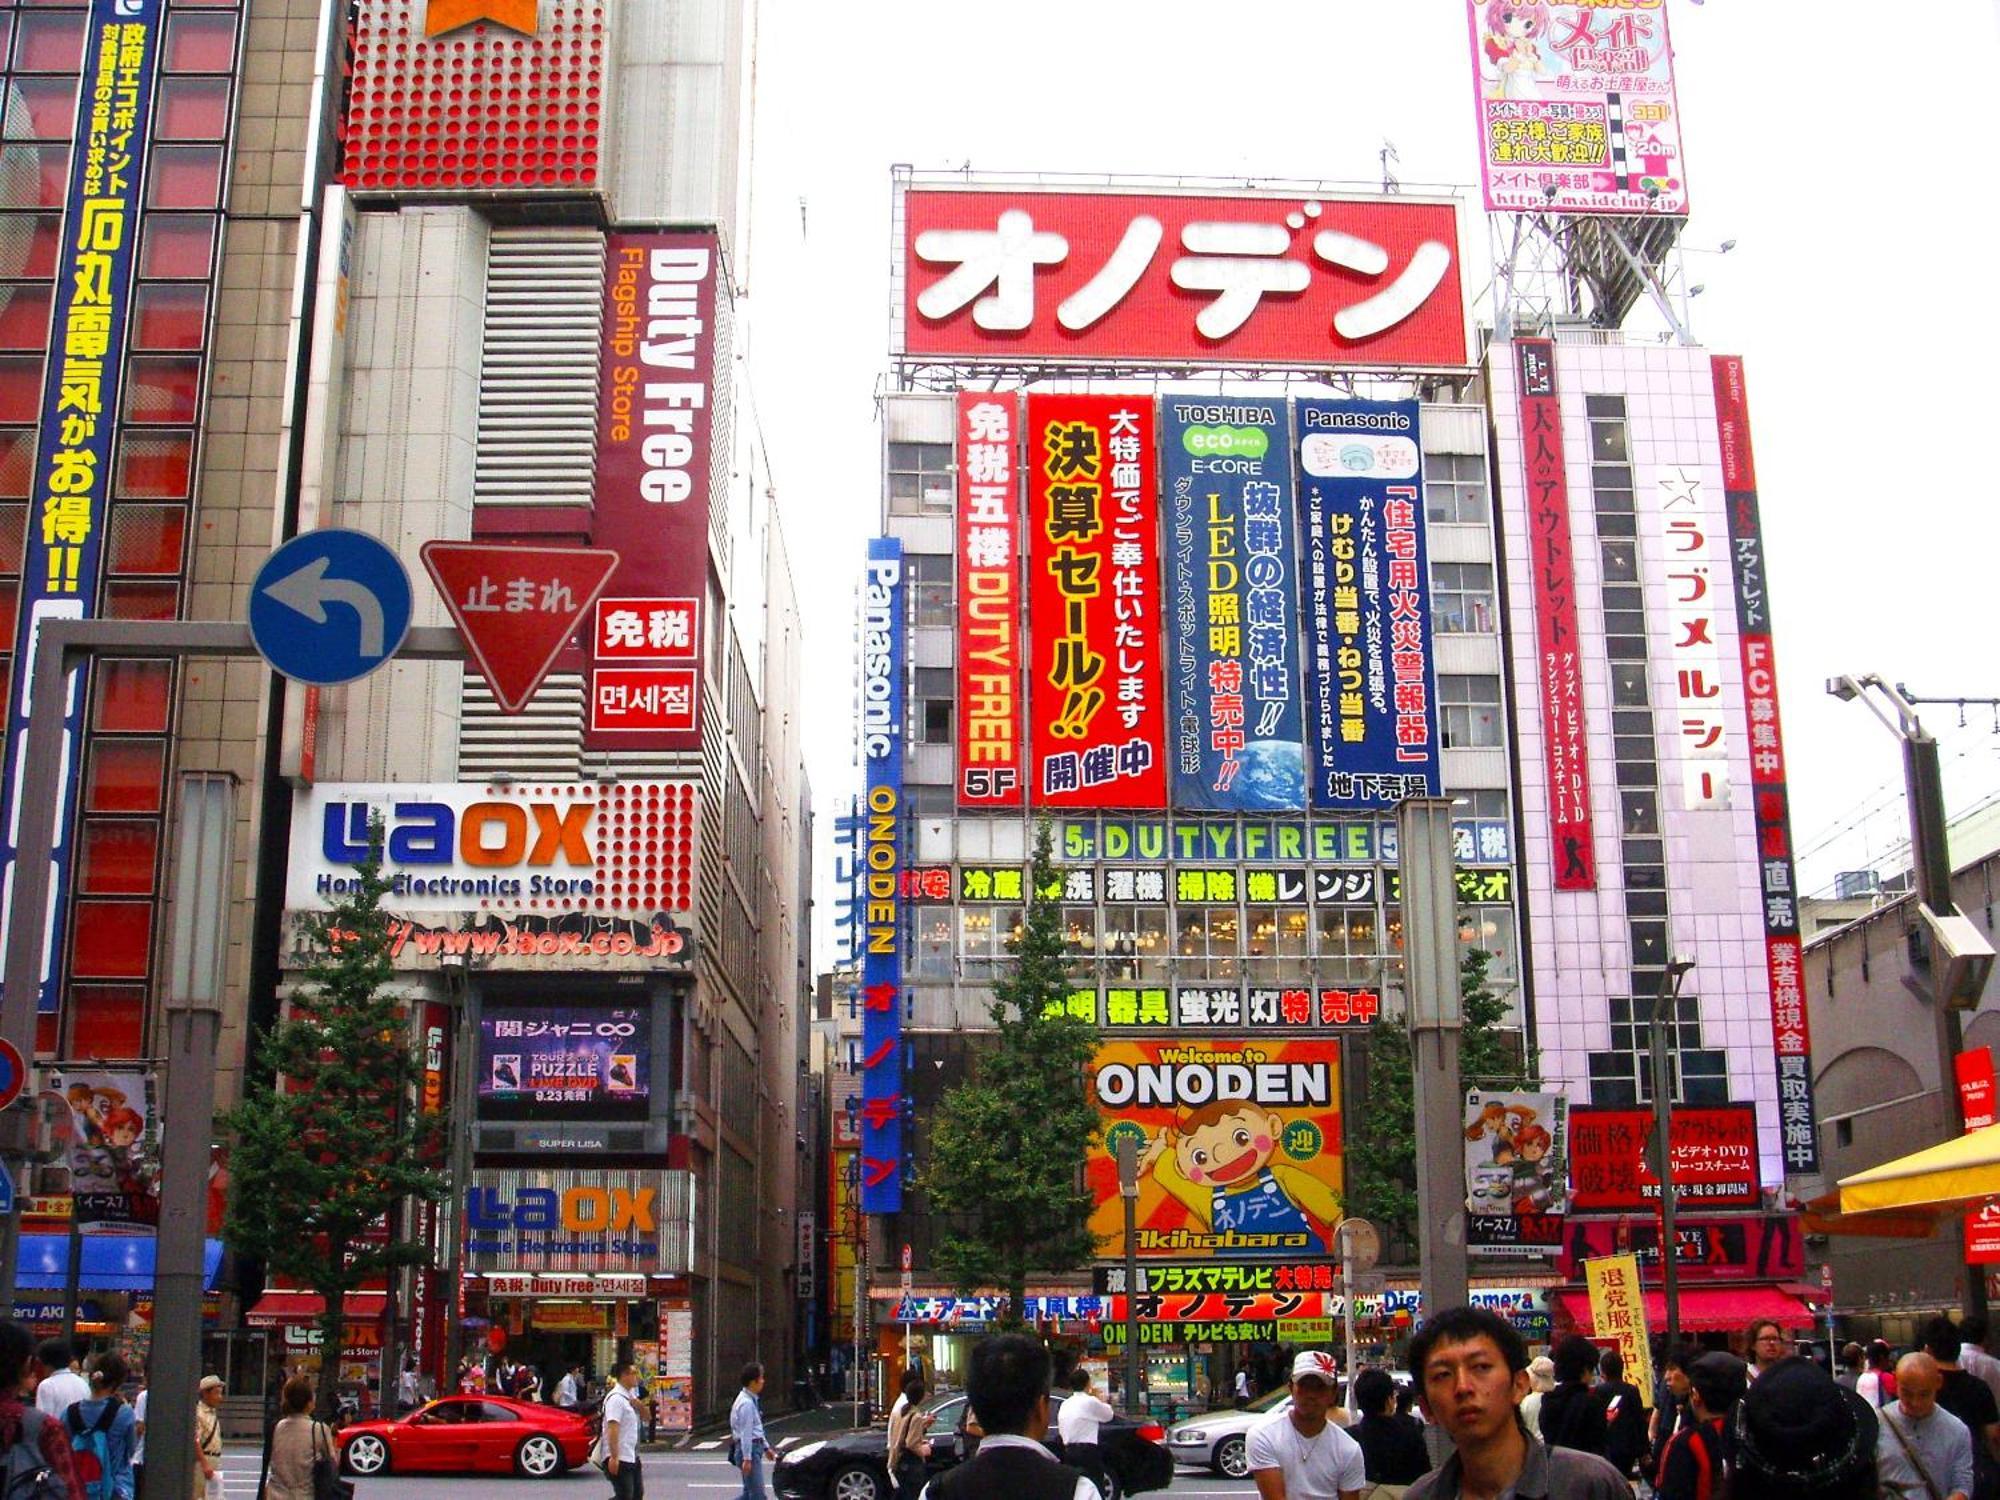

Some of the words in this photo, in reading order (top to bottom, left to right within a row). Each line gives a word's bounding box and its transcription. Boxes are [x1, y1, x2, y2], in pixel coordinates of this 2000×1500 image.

[108, 23, 147, 196] 政府エコポイント
[913, 200, 1451, 340] オノデン
[611, 247, 643, 356] Flagship
[640, 247, 711, 369] Duty
[611, 366, 640, 442] Store
[1727, 361, 1739, 402] Dealer
[1175, 405, 1276, 426] TOSHIBA
[1305, 409, 1410, 430] Panasonic
[639, 382, 705, 503] Free
[1192, 459, 1262, 476] E-CORE
[1532, 403, 1568, 644] 大人のアウトレット
[463, 575, 578, 614] 止まれ
[1046, 420, 1104, 740] 決算セール!!
[1108, 409, 1146, 730] 大特価でご奉仕いたします
[1206, 493, 1241, 657] LED照明
[605, 611, 690, 648] 免税
[968, 571, 1011, 669] DUTY
[1331, 513, 1366, 742] けむり当番・ねつ当番
[866, 559, 900, 759] Panasonic
[1666, 522, 1723, 799] ラブメルシー
[599, 685, 690, 715] 면세점
[969, 674, 1012, 763] FREE
[1747, 643, 1779, 775] FC募集中
[1546, 652, 1569, 824] ランジェリー・コスチューム
[965, 769, 1016, 797] 5F
[1044, 738, 1152, 796] 開催中
[1328, 772, 1426, 800] 地下売場
[393, 874, 521, 895] Electronics
[530, 874, 594, 895] Store
[868, 784, 897, 953] ONODEN
[1279, 872, 1373, 901] レンジ
[1281, 989, 1379, 1025] 特売中
[531, 1064, 598, 1077] PUZZLE
[1159, 1047, 1244, 1064] Welcome
[1245, 1048, 1267, 1063] to
[864, 980, 900, 1187] オノデン
[1097, 1063, 1331, 1106] ONODEN
[539, 1139, 575, 1149] SUPER
[577, 1140, 602, 1149] LISA
[1215, 1193, 1291, 1229] オノデン
[1148, 1267, 1272, 1292] プラズマテレビ
[40, 1306, 84, 1319] AKIA
[1104, 1325, 1173, 1344] ONDEN
